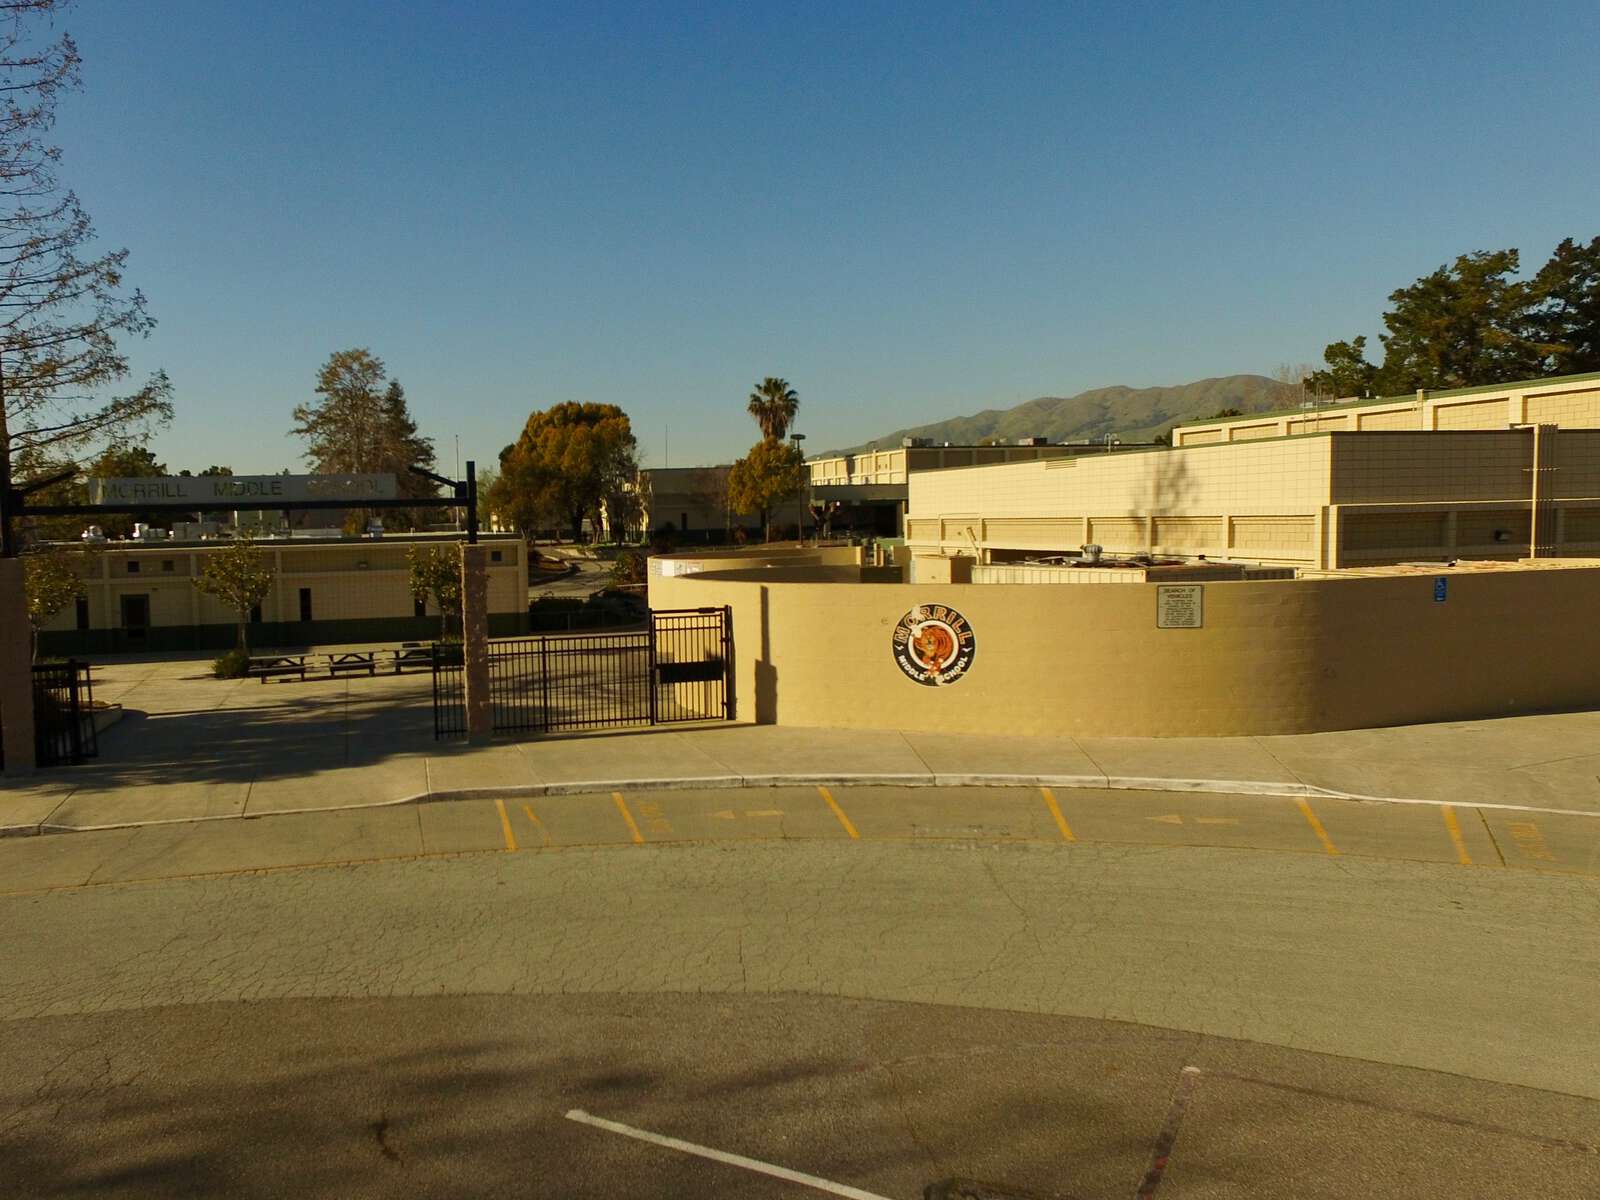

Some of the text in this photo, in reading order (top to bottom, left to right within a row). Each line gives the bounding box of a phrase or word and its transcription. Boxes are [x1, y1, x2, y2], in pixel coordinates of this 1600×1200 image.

[893, 605, 973, 645] MORRILL
[898, 655, 968, 682] MIDDLE CHOOL
